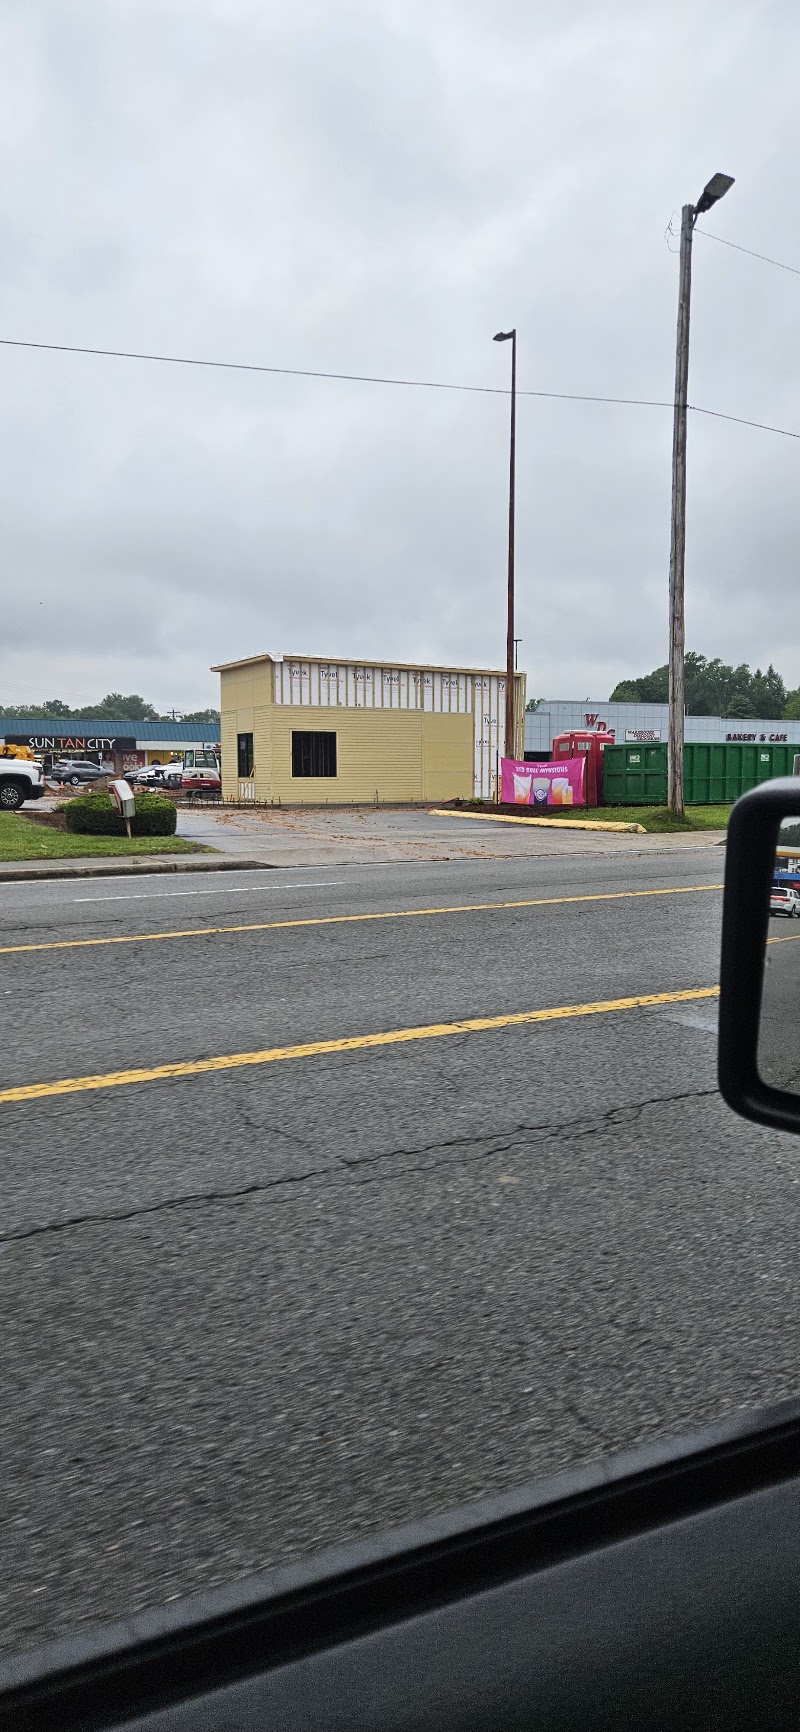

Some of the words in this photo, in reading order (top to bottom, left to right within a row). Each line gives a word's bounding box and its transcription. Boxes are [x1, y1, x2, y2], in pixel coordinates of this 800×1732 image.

[288, 667, 308, 676] Tyvk
[352, 672, 371, 681] Tyvk
[383, 674, 400, 683] Tyve
[726, 733, 757, 741] BAKERY
[760, 733, 767, 741] &
[769, 733, 788, 741] CAFE
[29, 737, 55, 748] SUN
[57, 737, 85, 749] TAN
[87, 738, 116, 749] CITY
